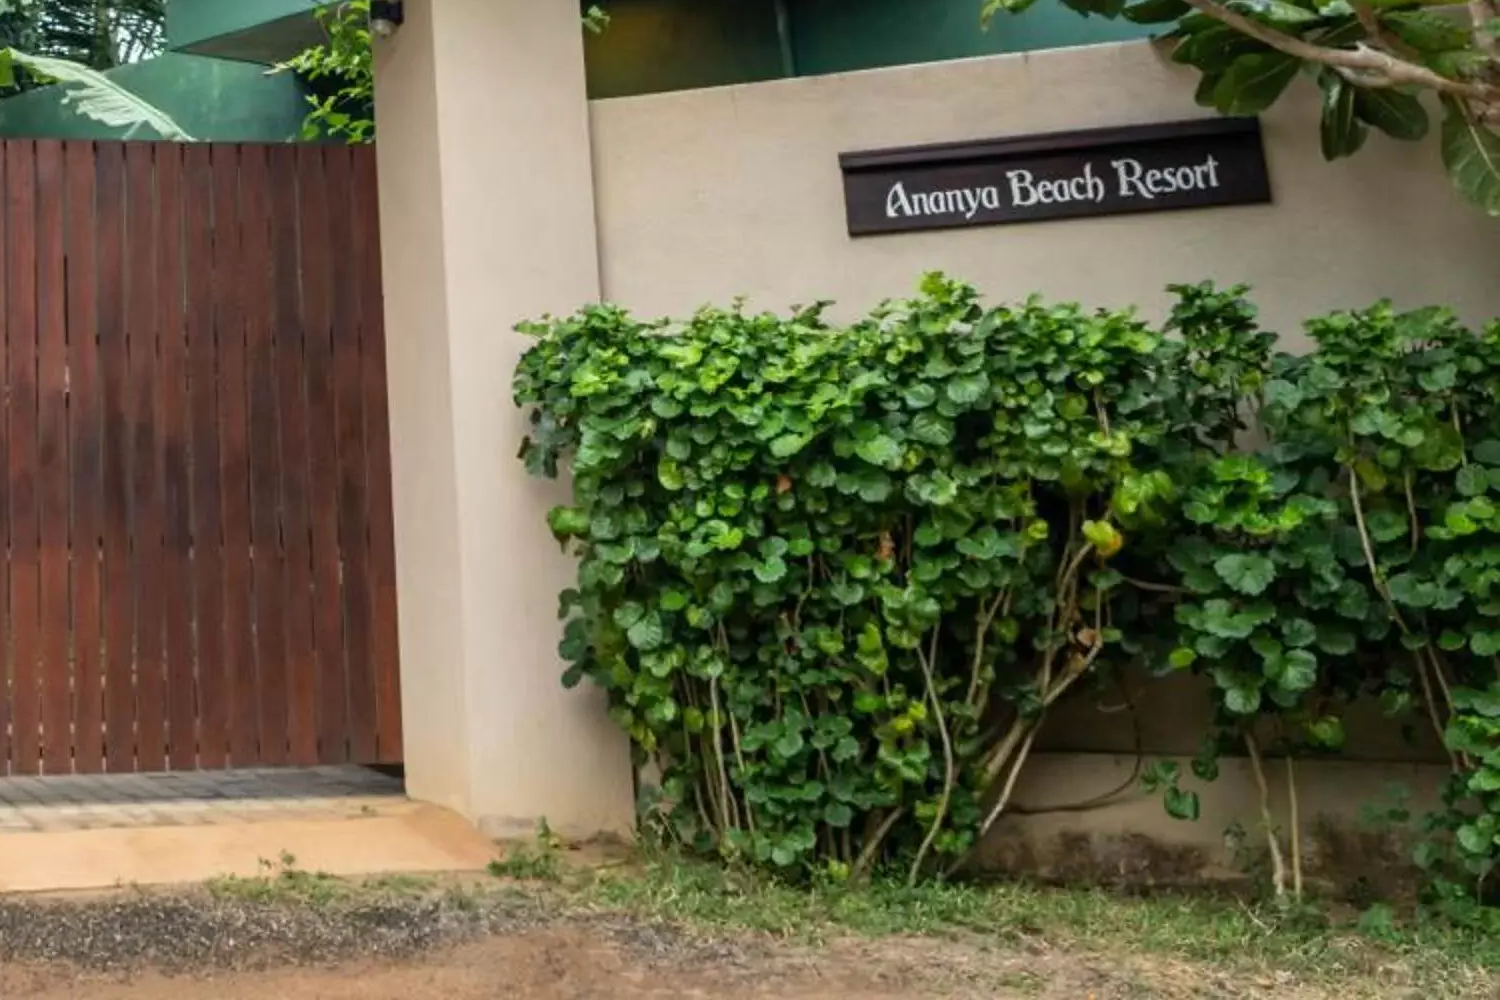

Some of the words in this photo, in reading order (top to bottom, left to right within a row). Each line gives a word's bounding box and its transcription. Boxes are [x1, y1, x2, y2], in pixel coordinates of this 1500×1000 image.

[886, 182, 999, 219] Ananya
[1006, 163, 1104, 207] Beach
[1111, 156, 1219, 199] Resort
